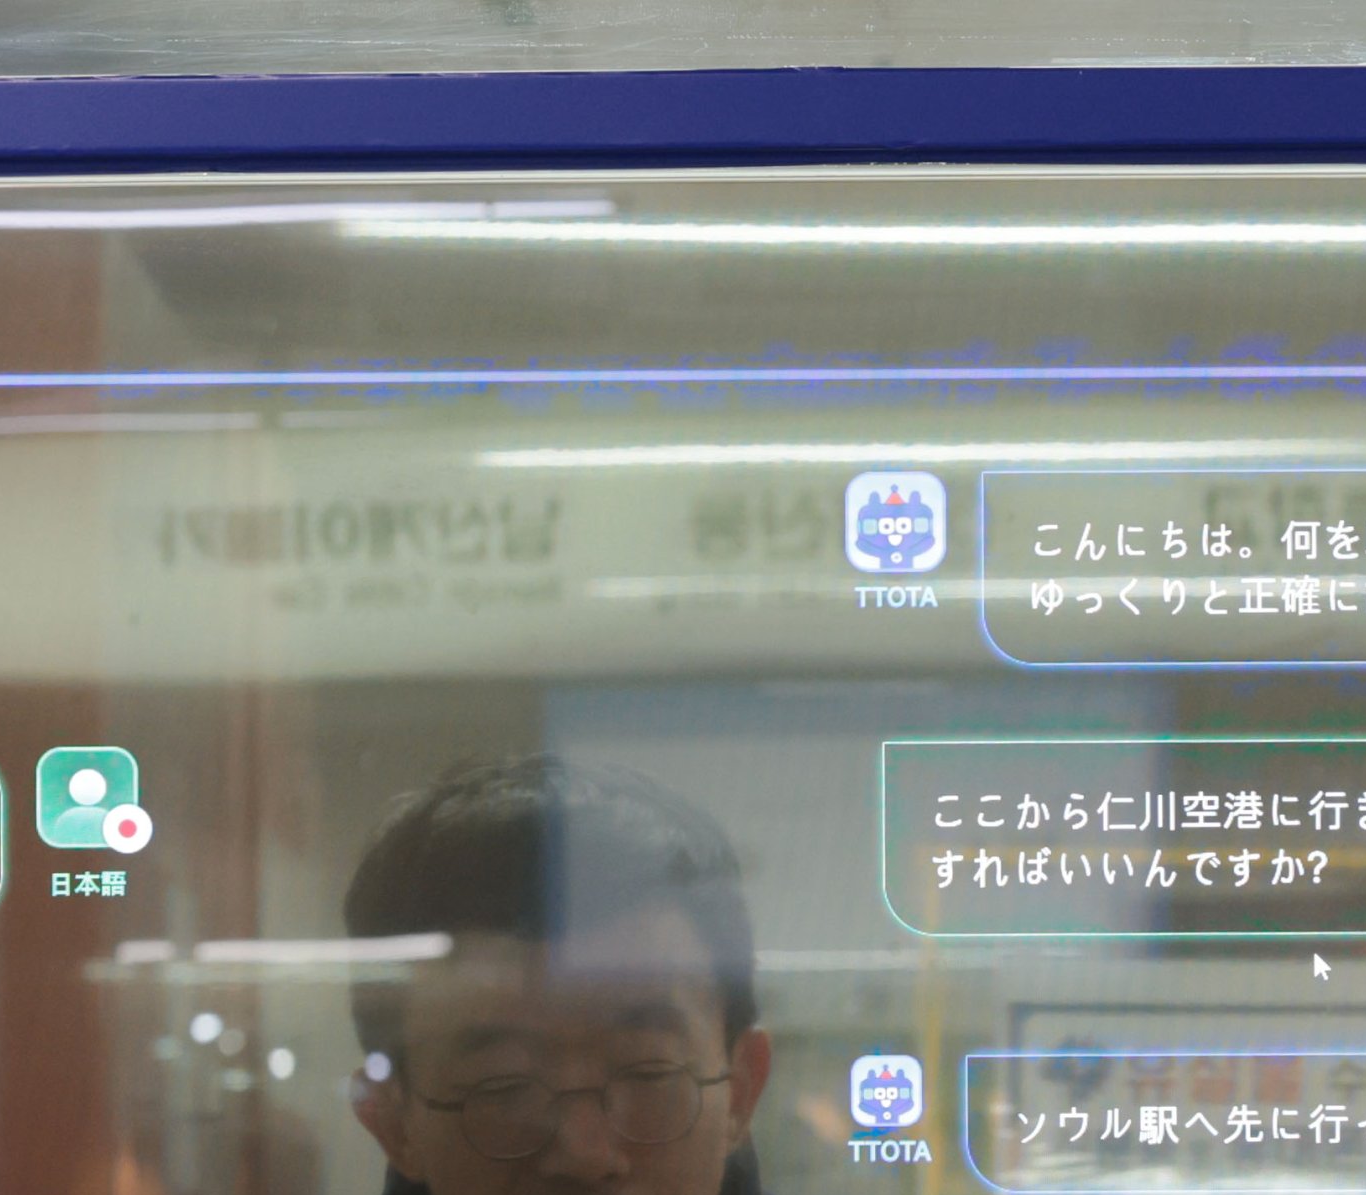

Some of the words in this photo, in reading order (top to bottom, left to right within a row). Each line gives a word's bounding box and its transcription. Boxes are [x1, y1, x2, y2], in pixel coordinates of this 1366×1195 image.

[853, 584, 937, 607] TTOTA
[52, 871, 126, 896] 日本語
[848, 1140, 932, 1162] TTOTA
